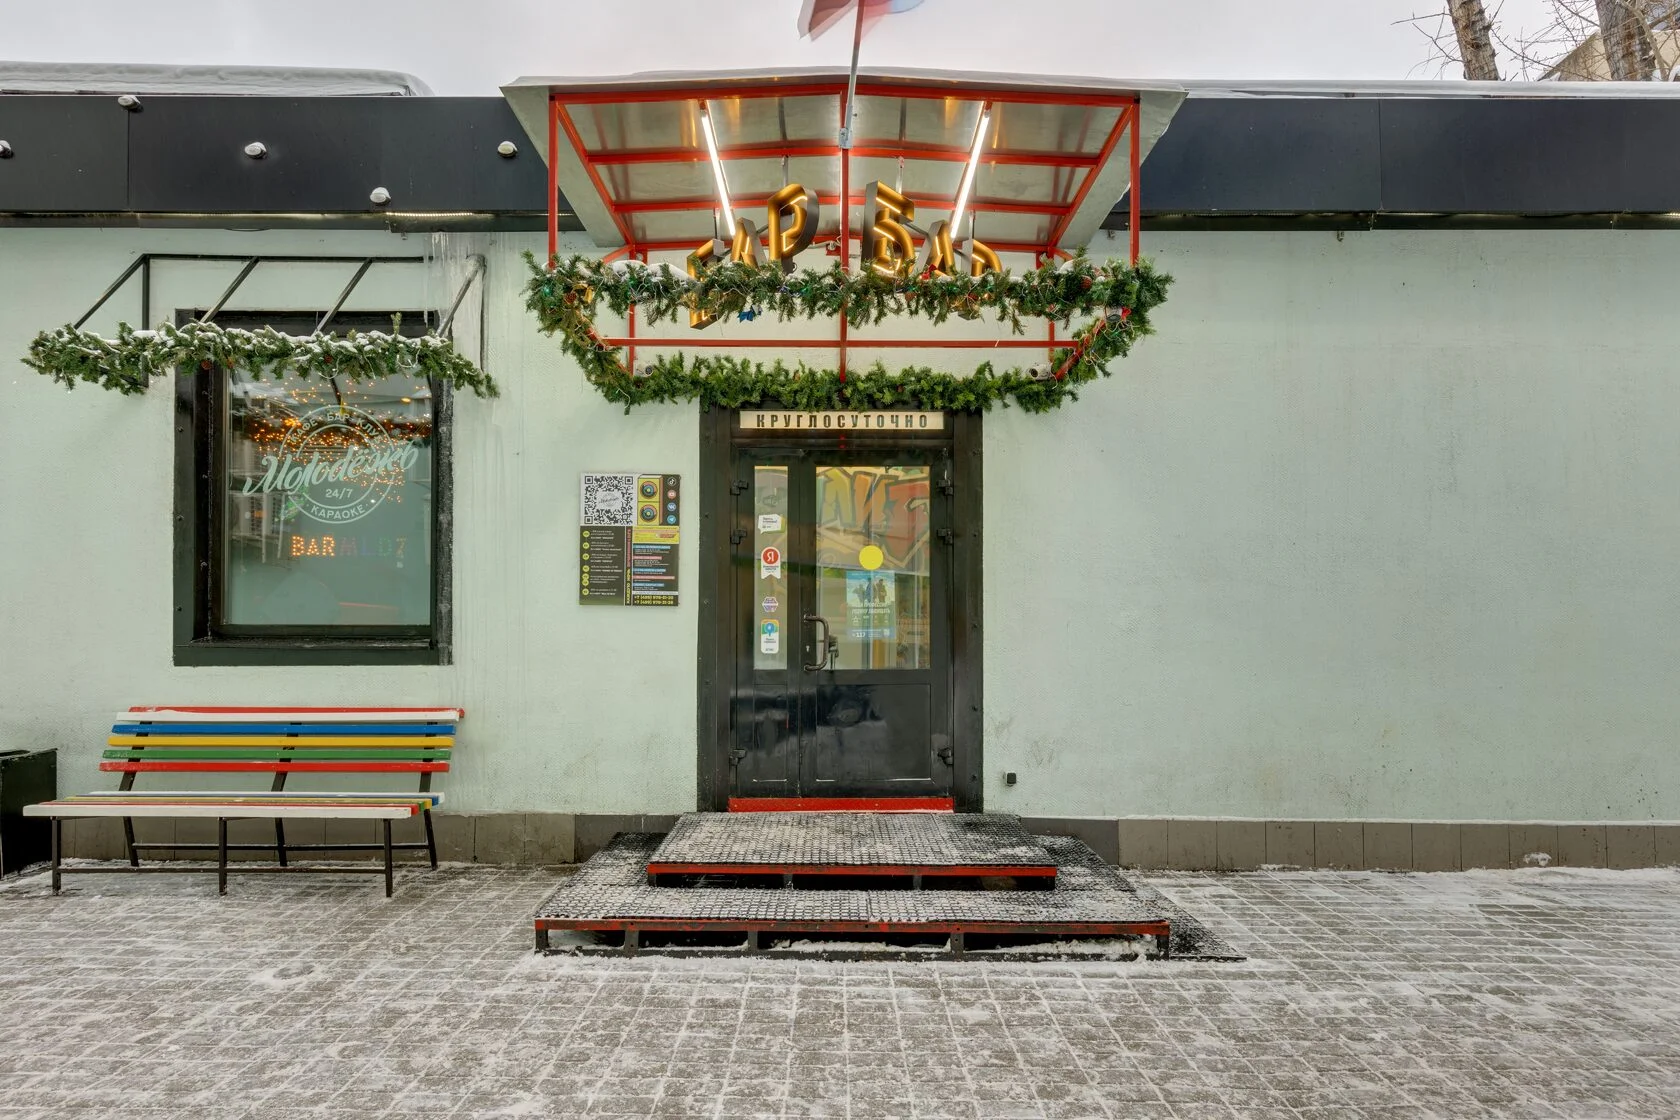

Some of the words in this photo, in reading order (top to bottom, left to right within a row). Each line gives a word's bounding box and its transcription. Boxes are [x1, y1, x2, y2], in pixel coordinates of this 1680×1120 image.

[290, 418, 318, 444] КАФЕ
[326, 413, 350, 422] БАР
[357, 418, 384, 444] КЛУБ
[756, 414, 928, 428] КРУГЛОСУТОЧНО
[325, 488, 353, 500] 24/7
[310, 504, 366, 520] КАРАОКЕ
[291, 535, 335, 557] BAR
